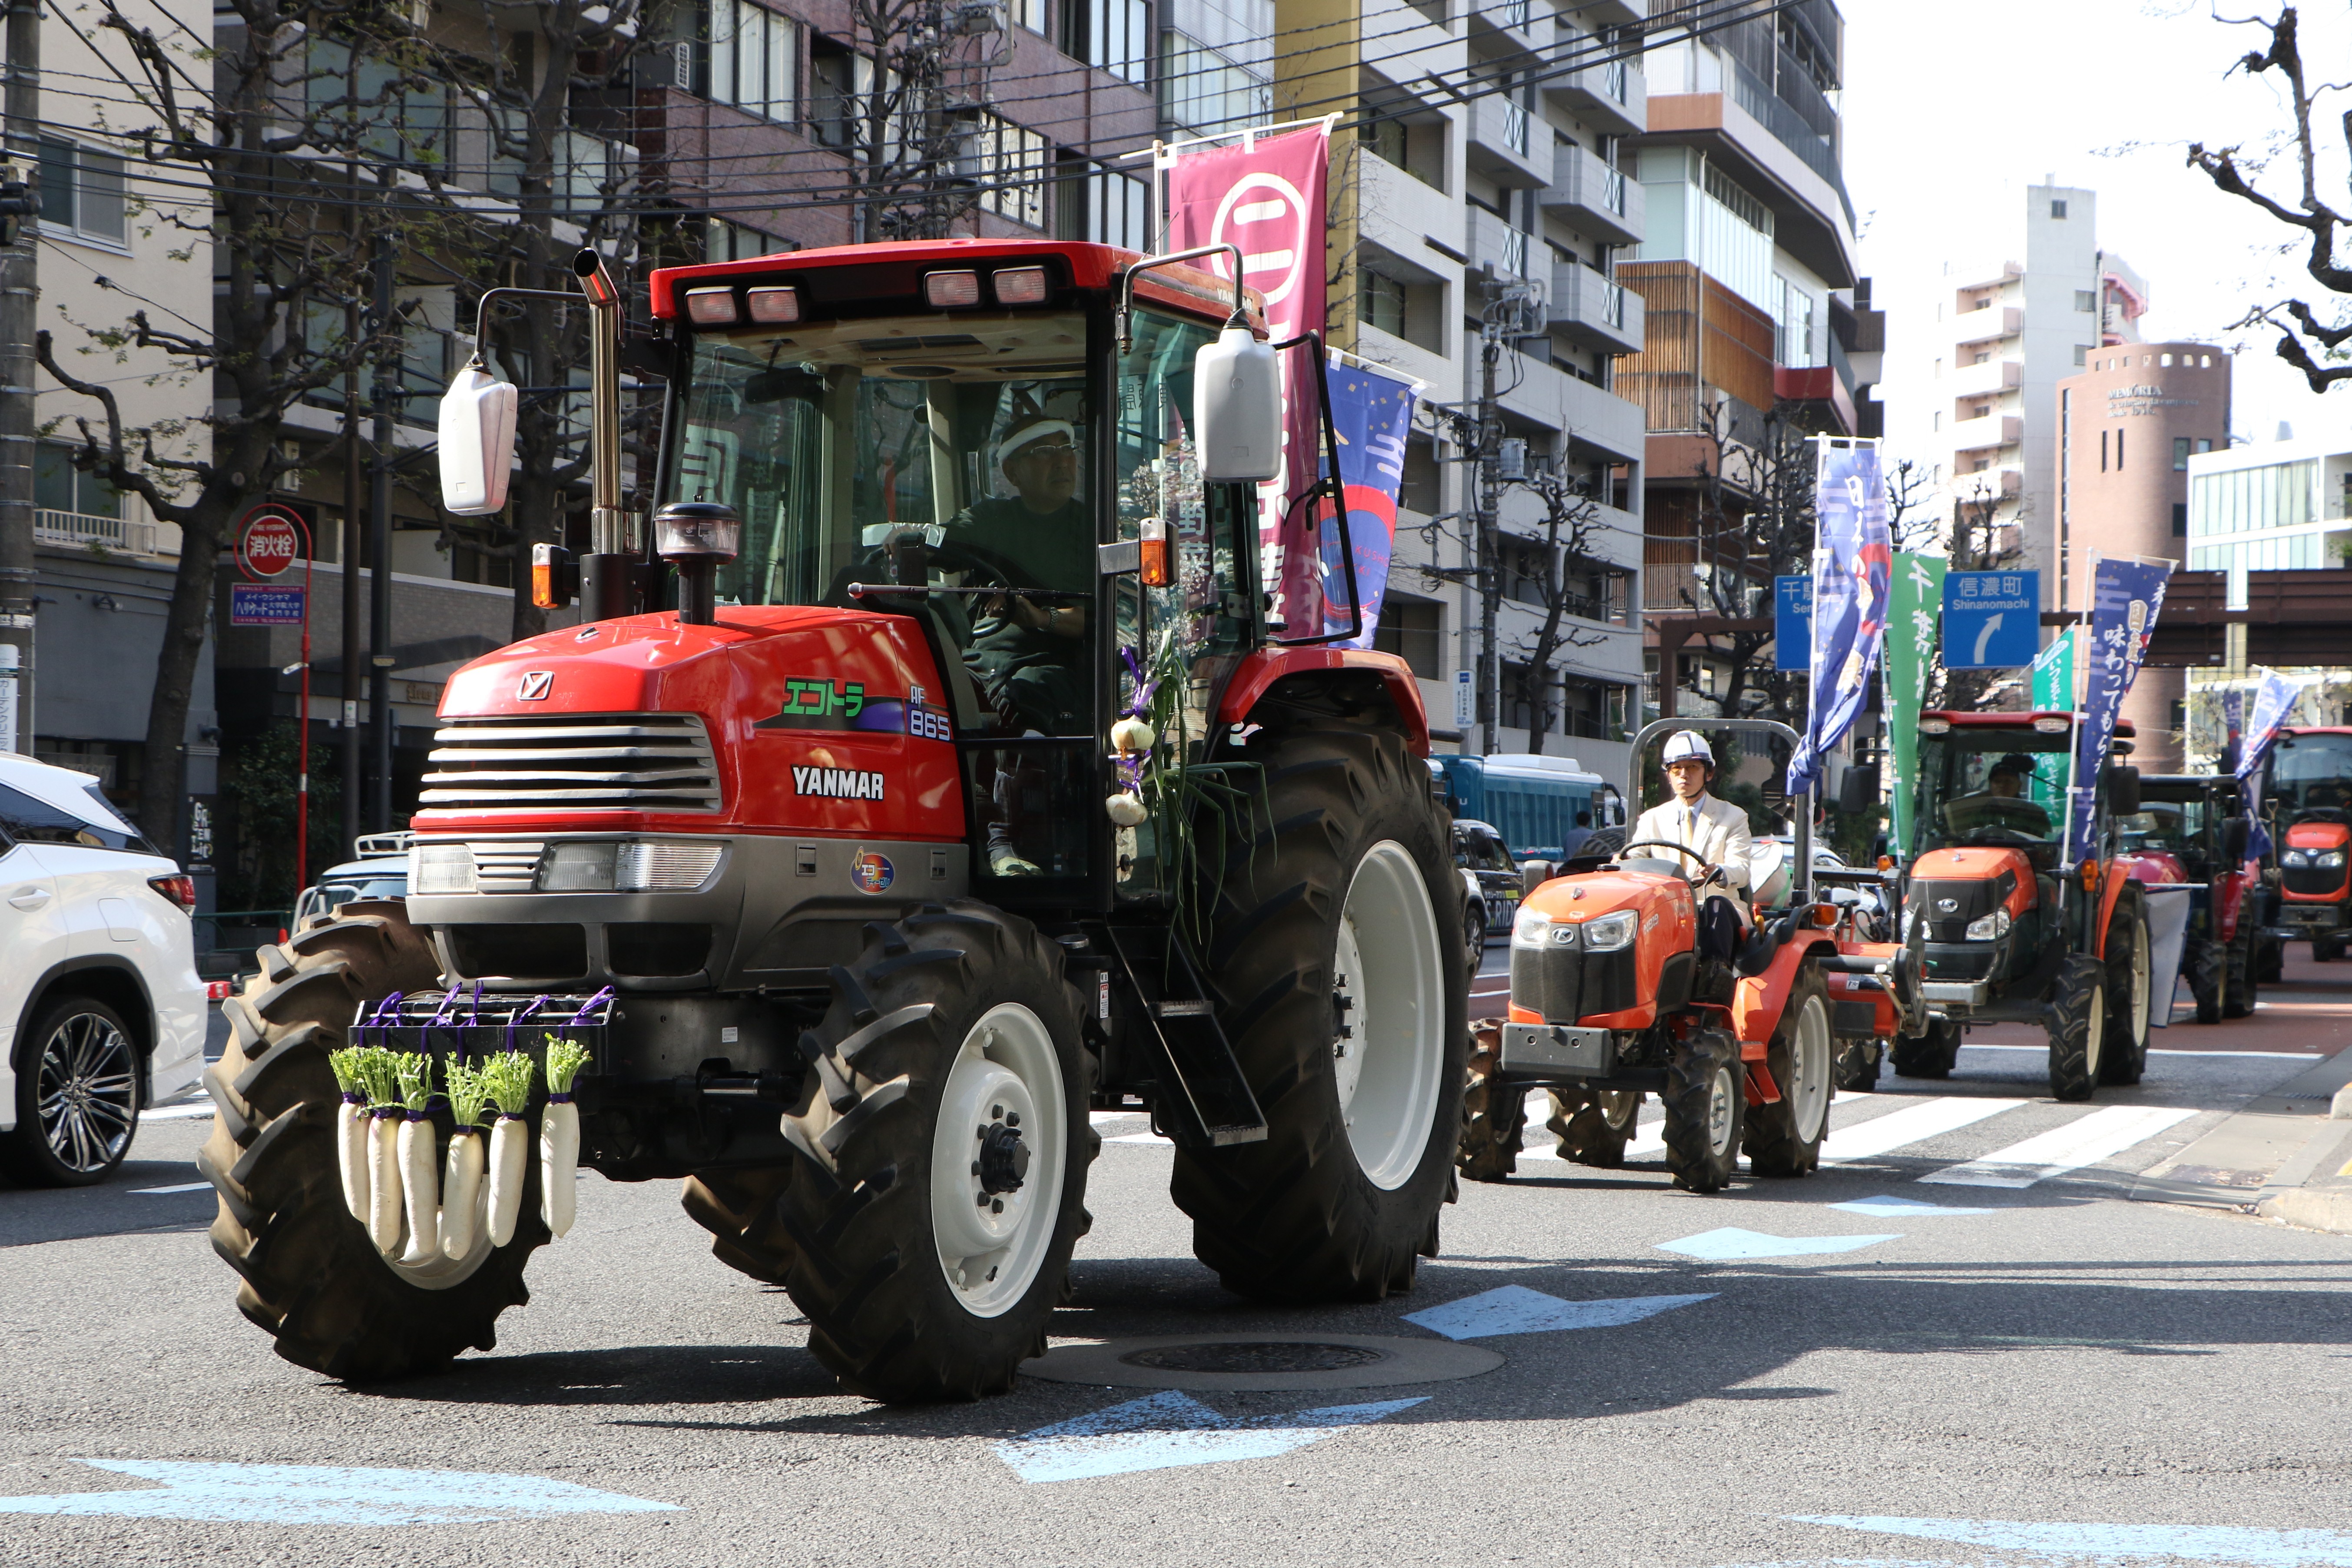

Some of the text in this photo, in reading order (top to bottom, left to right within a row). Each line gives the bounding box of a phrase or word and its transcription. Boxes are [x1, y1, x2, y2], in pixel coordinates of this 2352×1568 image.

[1217, 288, 1253, 310] YANAR
[250, 534, 293, 557] 消火栓
[1959, 576, 2023, 597] 信濃町
[1953, 598, 2030, 611] Shinanomachi
[783, 681, 864, 717] エコトラ
[910, 686, 925, 710] AF
[911, 710, 951, 741] 865
[792, 766, 884, 800] YANMAR
[861, 864, 875, 876] エコ
